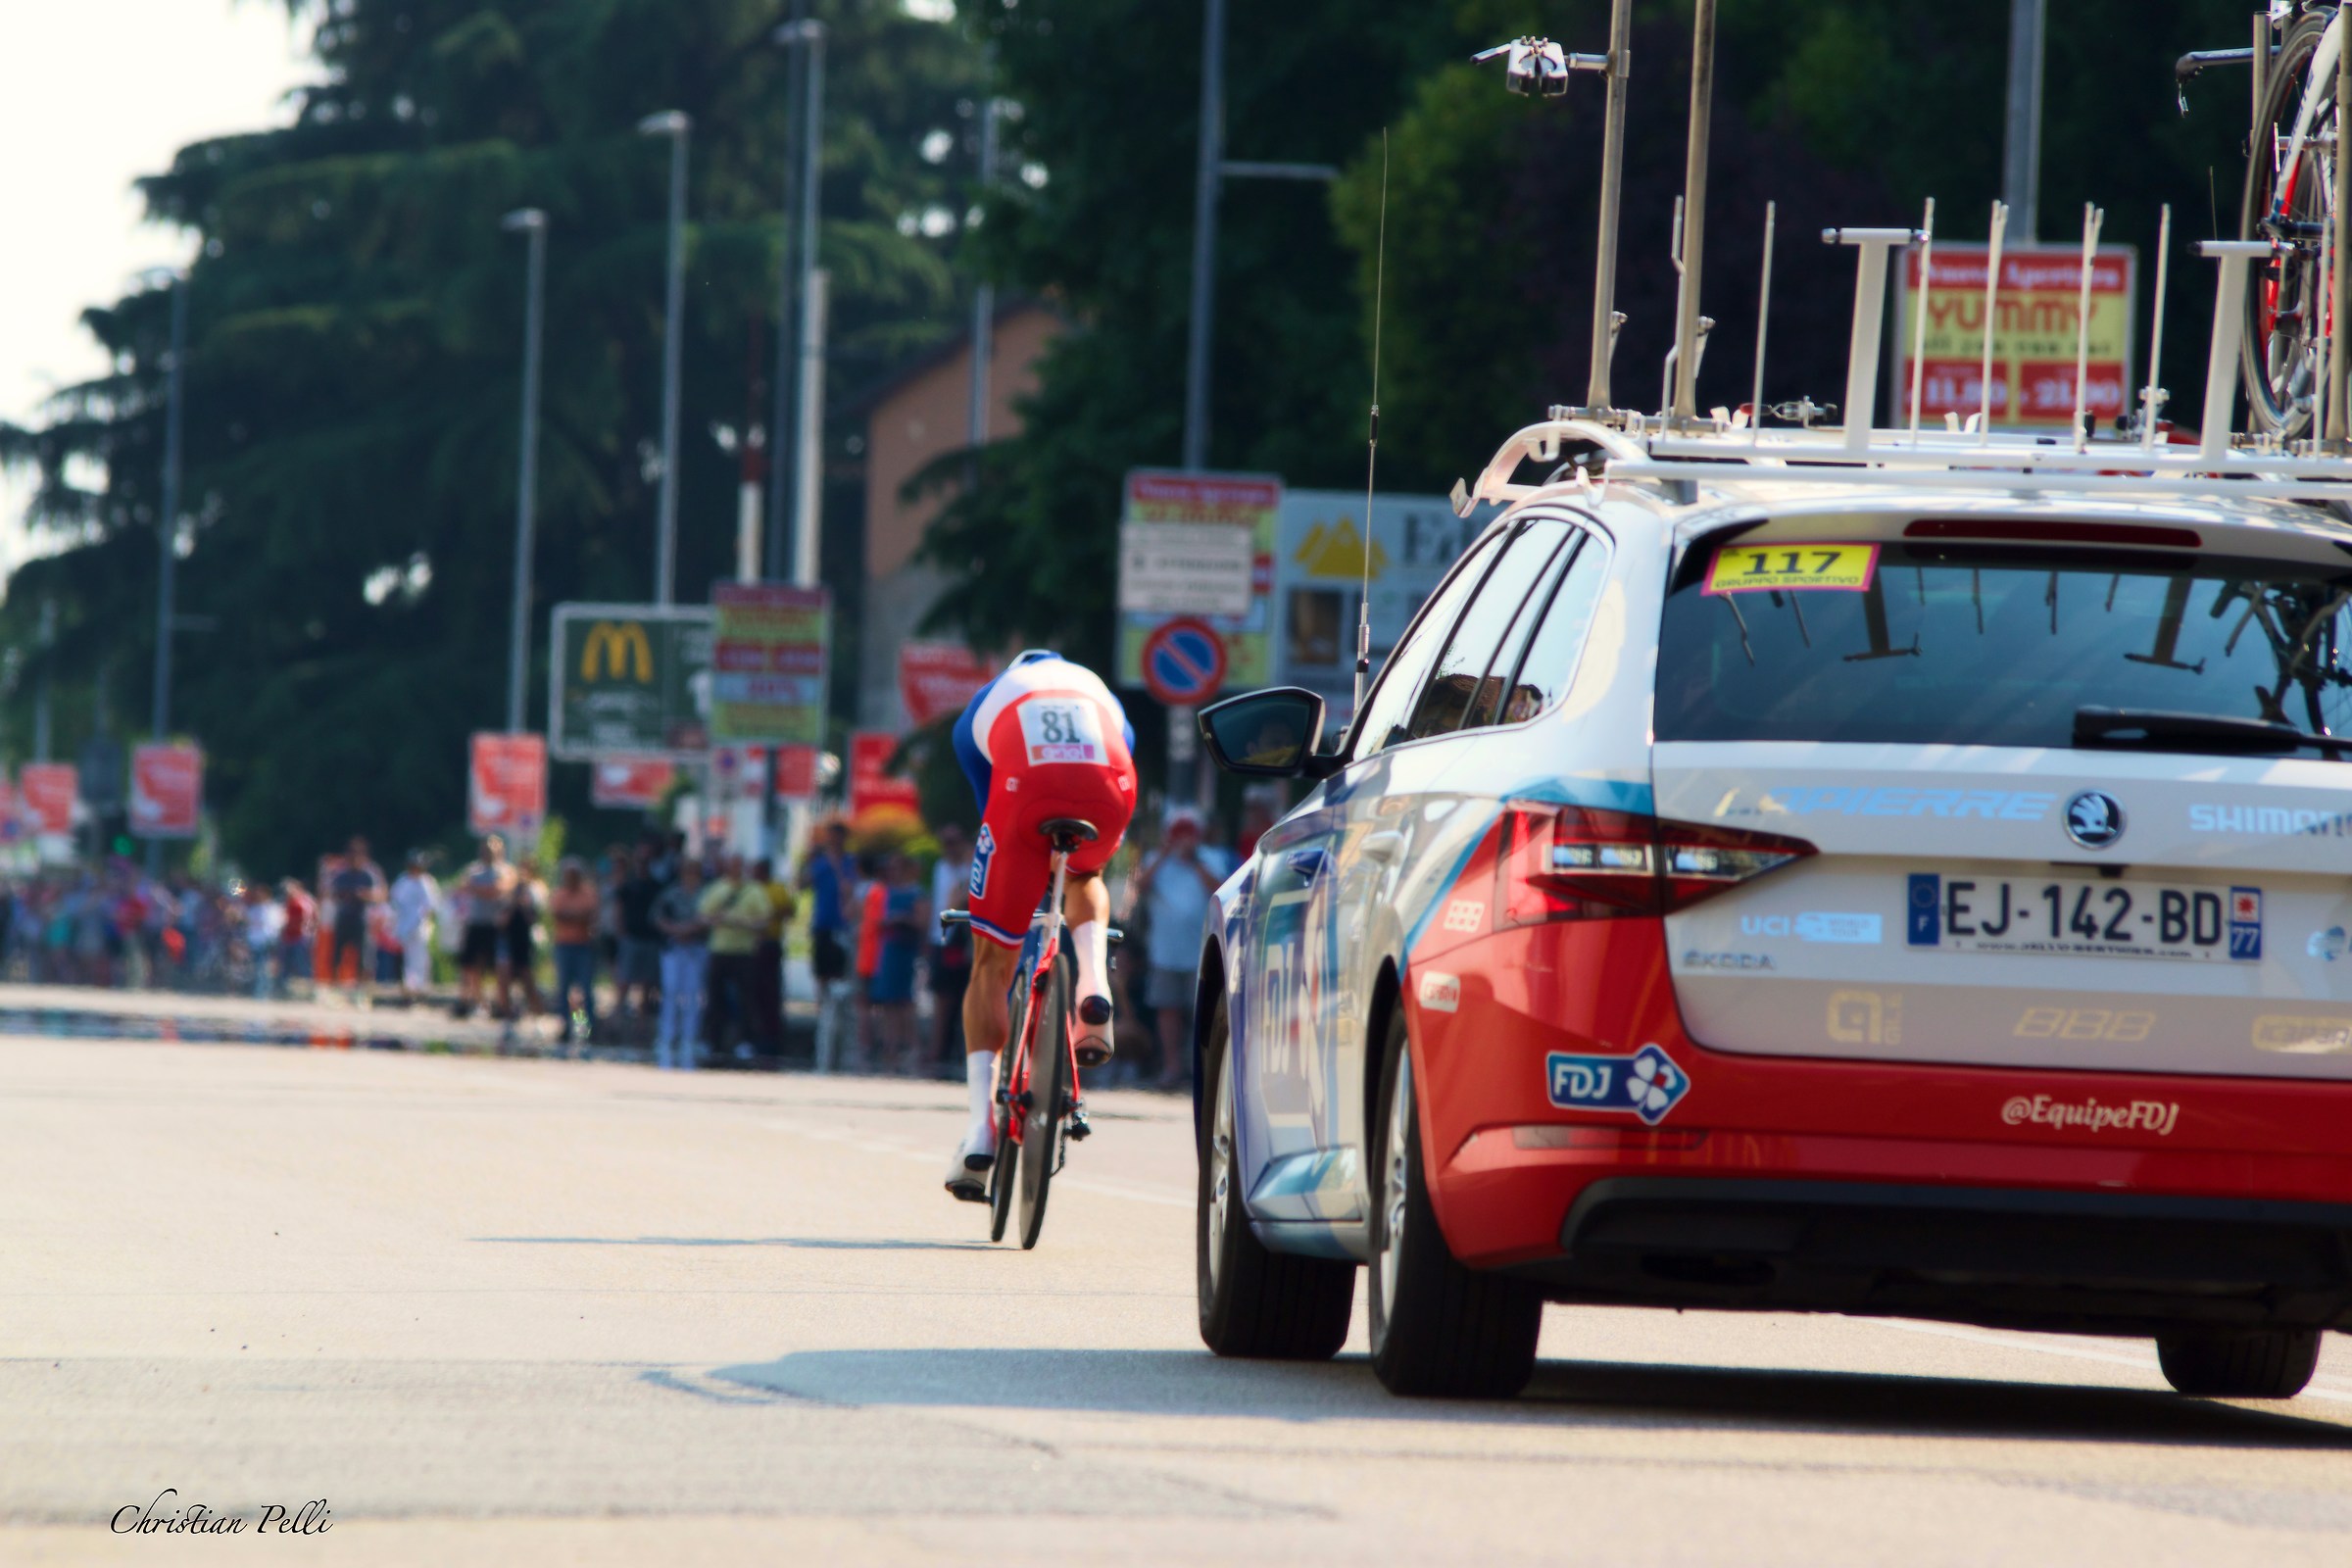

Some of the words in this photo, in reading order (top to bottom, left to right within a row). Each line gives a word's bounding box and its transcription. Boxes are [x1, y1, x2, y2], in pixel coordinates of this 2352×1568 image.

[1742, 551, 1841, 575] 117
[1716, 576, 1779, 588] GRUPPO
[1783, 574, 1860, 585] SPORTIVO
[1041, 710, 1081, 744] 81
[2189, 804, 2352, 836] SHIMAN
[1741, 914, 1789, 937] UCI
[1918, 916, 1930, 931] F
[1947, 881, 2223, 947] EJ-142-BD
[2232, 927, 2259, 953] 77
[1553, 1062, 1612, 1100] FDJ
[2001, 1094, 2180, 1136] @EquipeFDJ
